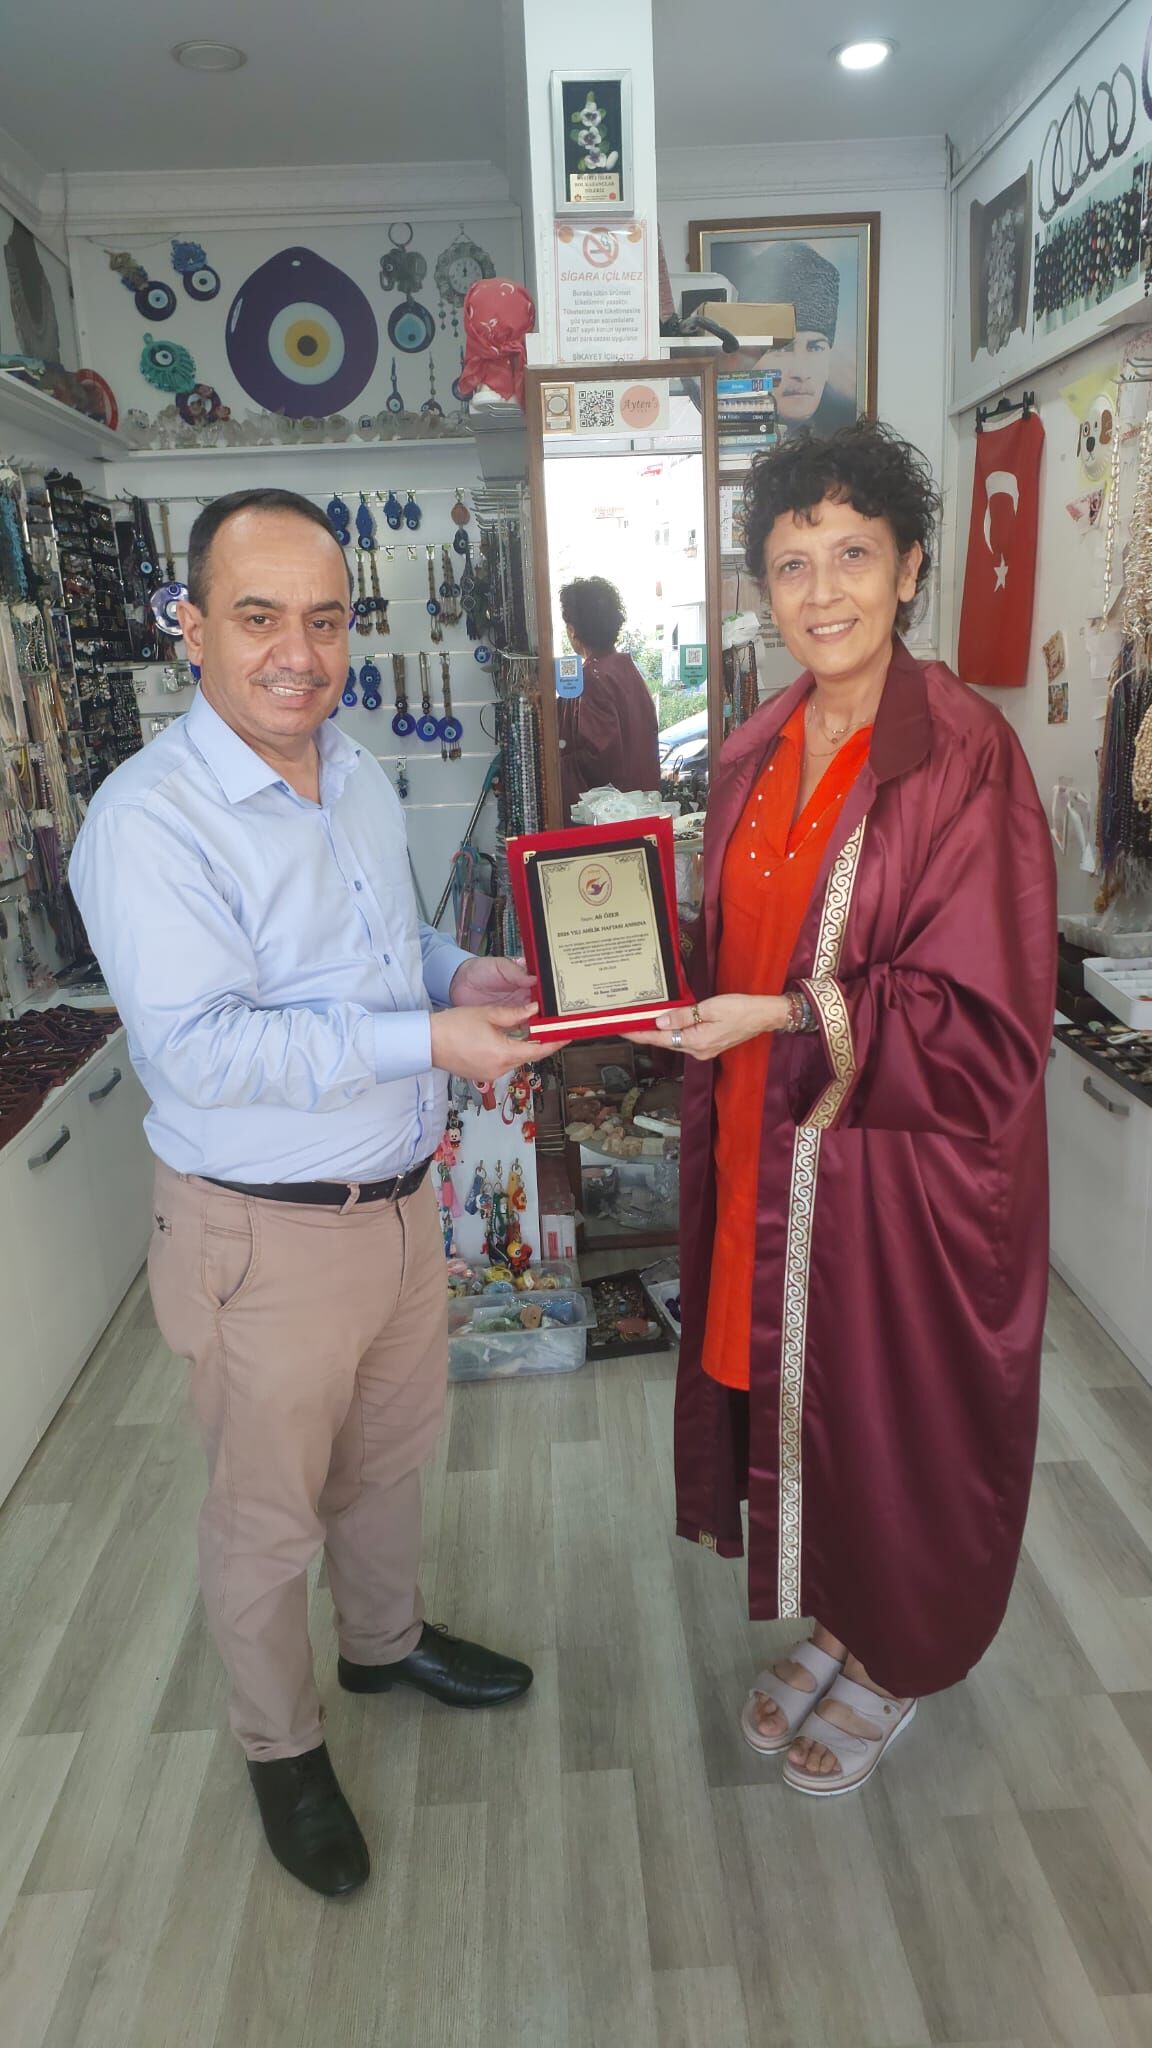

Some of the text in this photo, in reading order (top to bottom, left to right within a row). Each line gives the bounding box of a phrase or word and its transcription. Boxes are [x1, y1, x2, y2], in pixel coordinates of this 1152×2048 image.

[560, 270, 644, 282] SİGARA İÇİLMEZ
[622, 397, 658, 412] Ayten's
